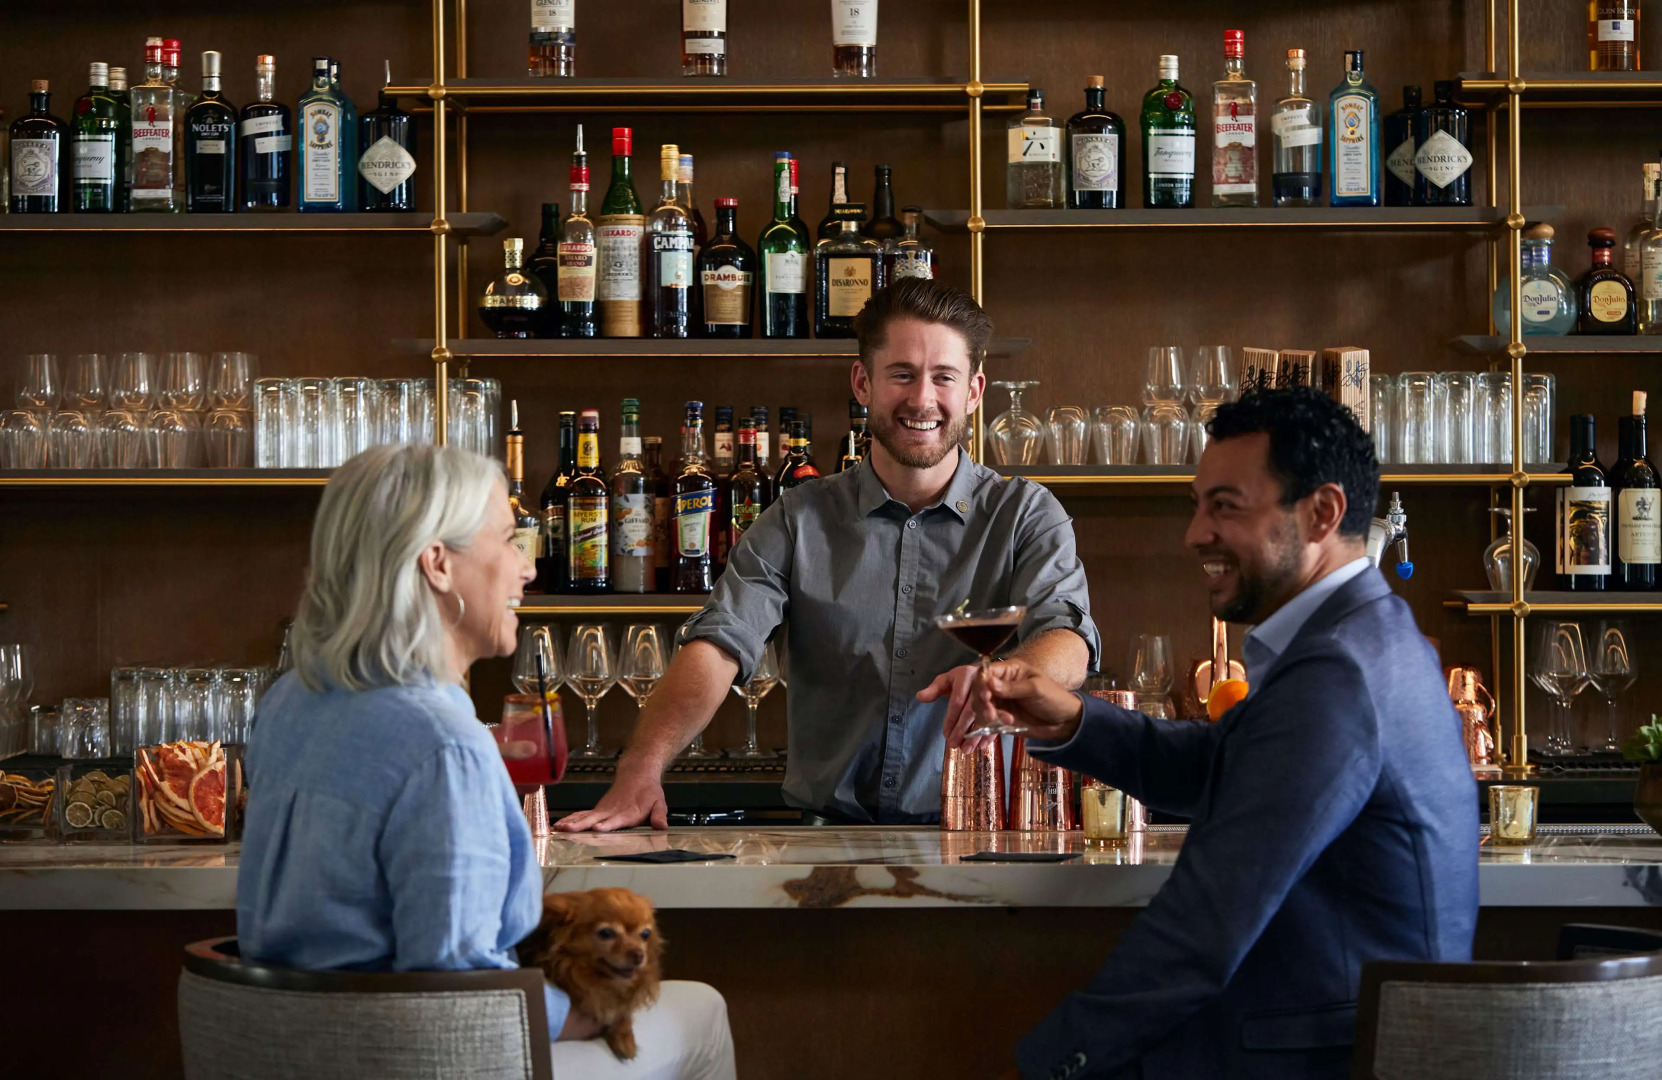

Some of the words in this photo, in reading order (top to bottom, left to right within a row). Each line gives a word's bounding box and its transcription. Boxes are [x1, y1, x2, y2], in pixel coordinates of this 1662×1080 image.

[850, 8, 859, 16] 18
[1341, 102, 1364, 112] BOMBAY
[310, 109, 332, 119] BOMBAY
[134, 128, 170, 138] BEEFEATER
[1217, 123, 1253, 133] BEEFEATER
[1417, 155, 1468, 164] HENDRICK'S
[654, 236, 694, 249] CAMPAR
[832, 279, 869, 287] DISARONNO
[486, 297, 542, 305] CHAMBO
[674, 494, 713, 513] APEROL
